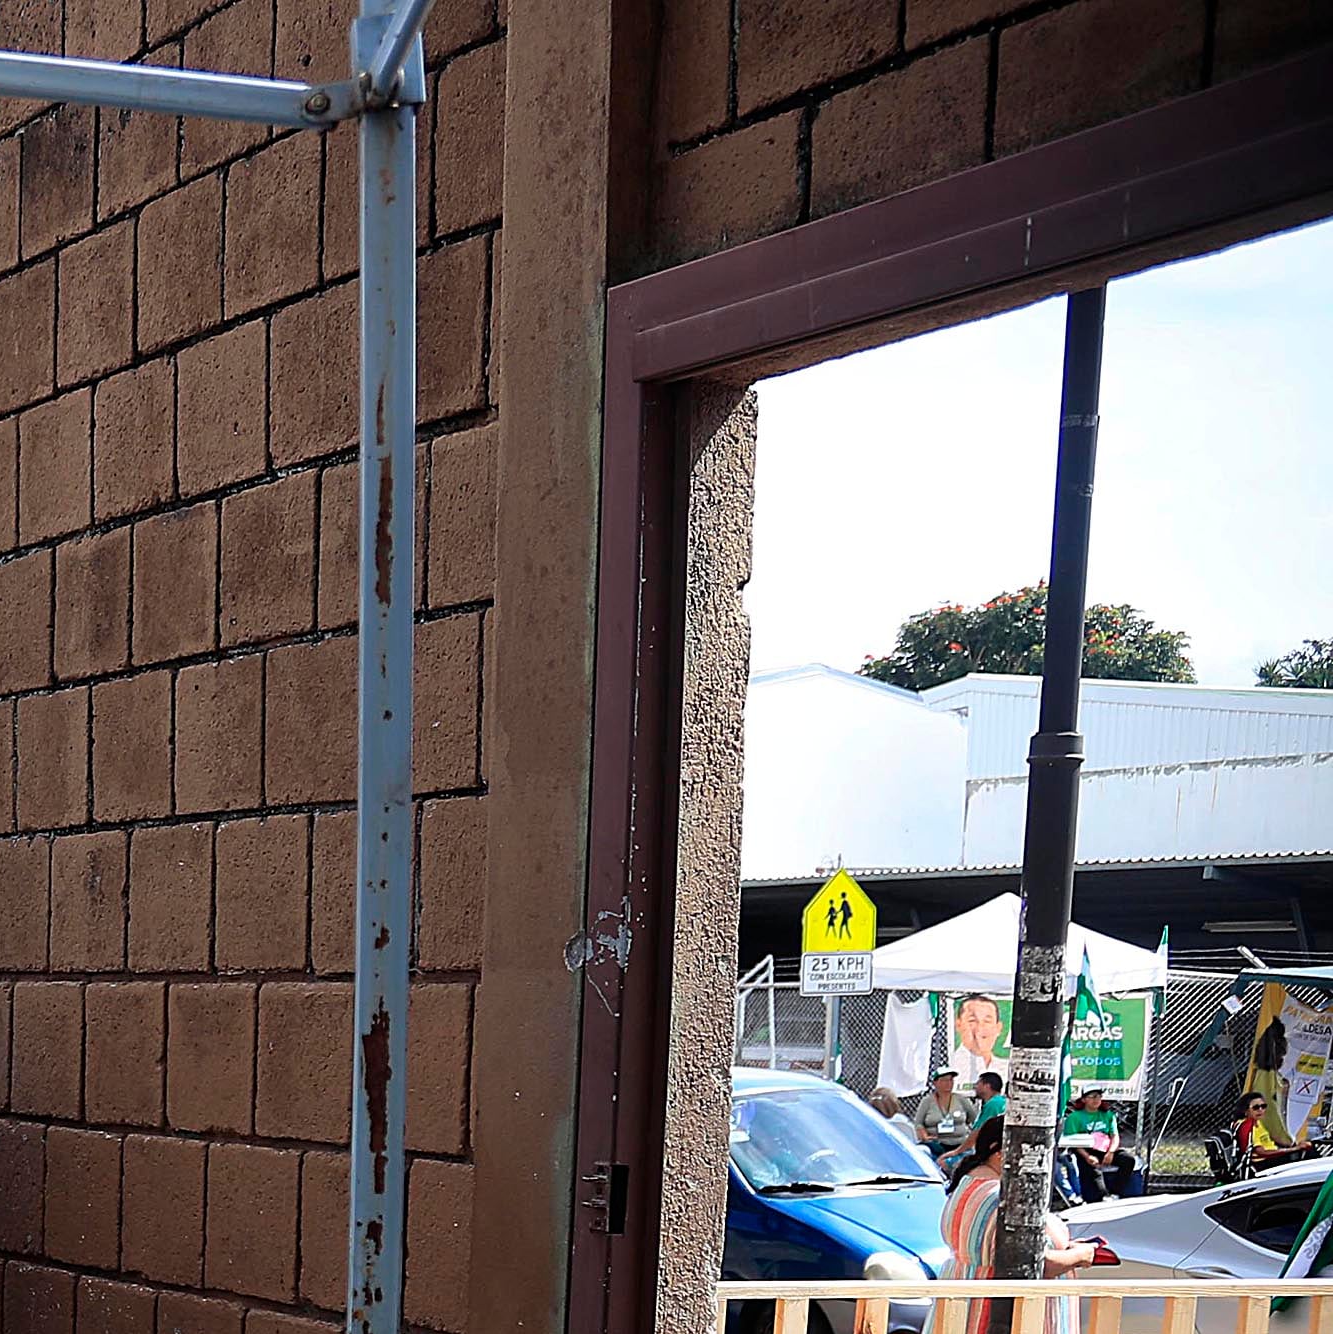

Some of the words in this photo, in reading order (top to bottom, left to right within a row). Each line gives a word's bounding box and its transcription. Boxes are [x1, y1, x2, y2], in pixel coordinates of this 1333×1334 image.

[811, 957, 830, 972] 25
[837, 956, 864, 971] KPH
[1070, 1026, 1123, 1041] ARGAS
[1070, 1041, 1121, 1049] CALDE
